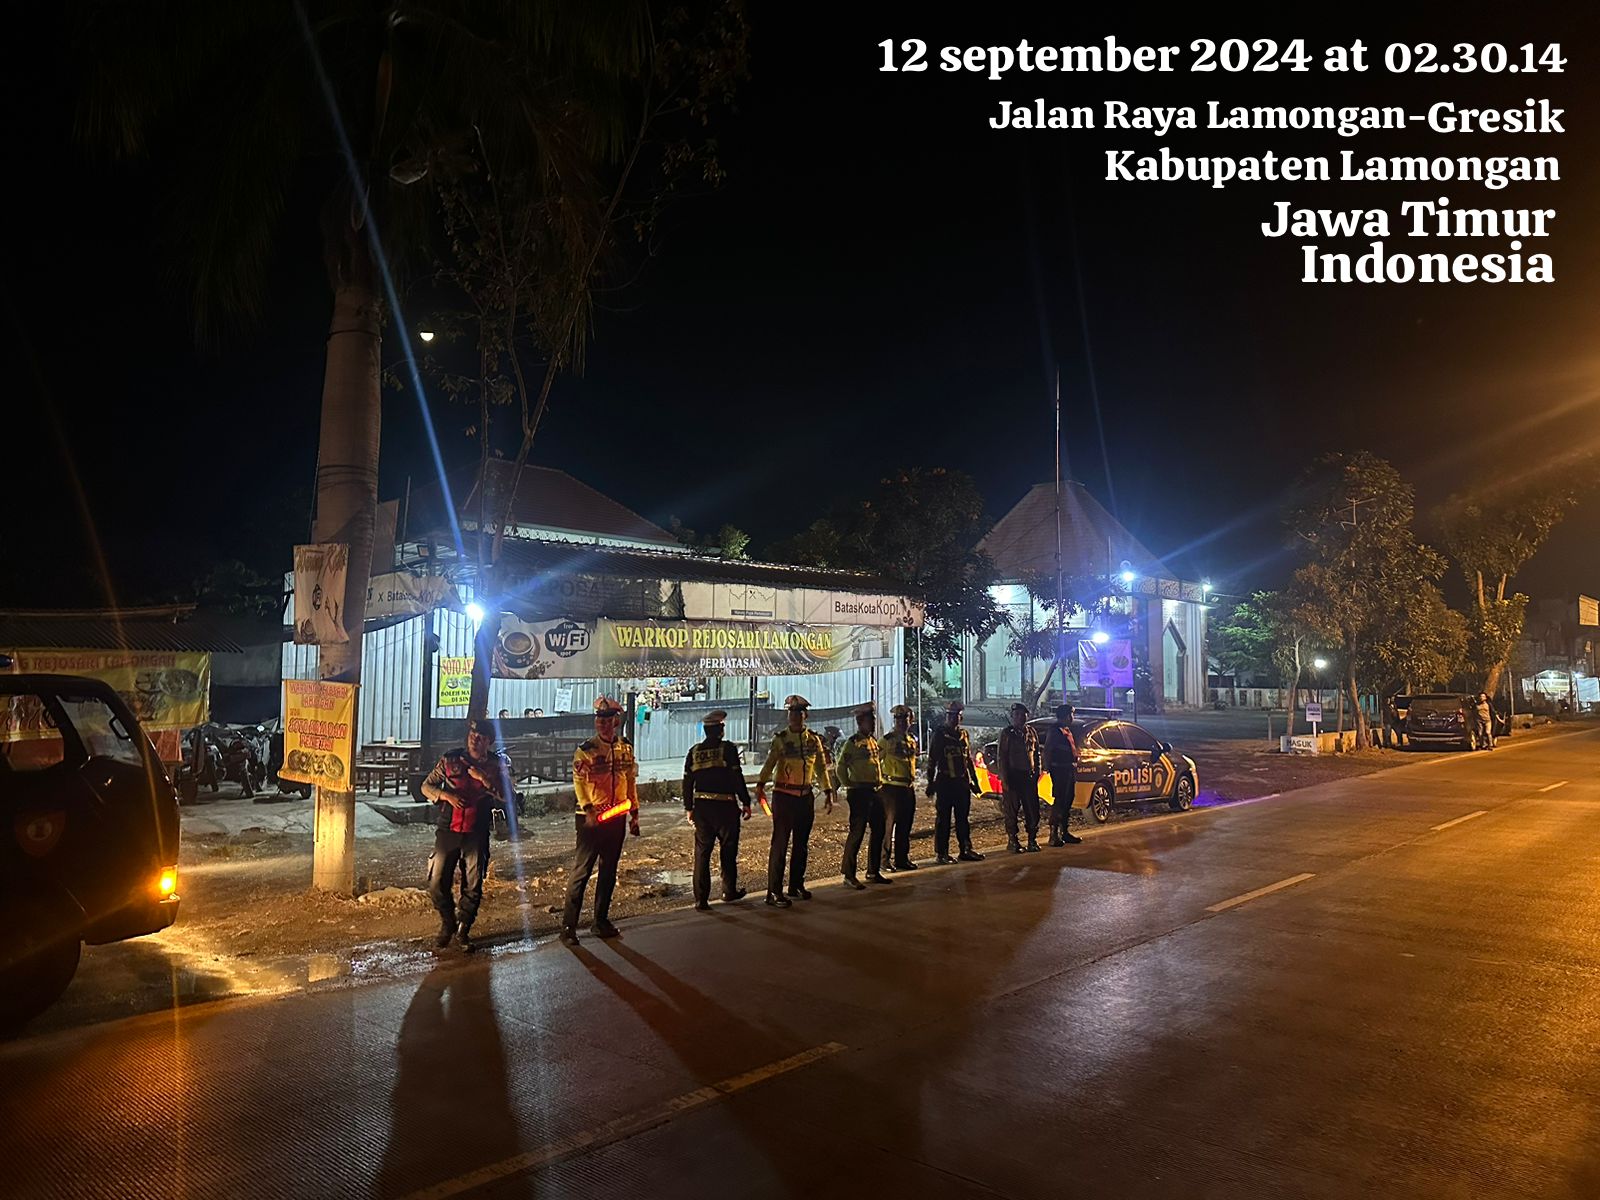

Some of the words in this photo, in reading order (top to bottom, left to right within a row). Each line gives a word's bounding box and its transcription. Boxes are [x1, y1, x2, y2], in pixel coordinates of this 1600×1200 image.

[617, 626, 689, 648] WARKOP
[692, 629, 759, 650] REJOSARI
[763, 629, 832, 650] LAMONGAN
[442, 659, 461, 676] SOTO
[699, 658, 761, 669] PERBATASAN
[1113, 767, 1153, 787] POLISI
